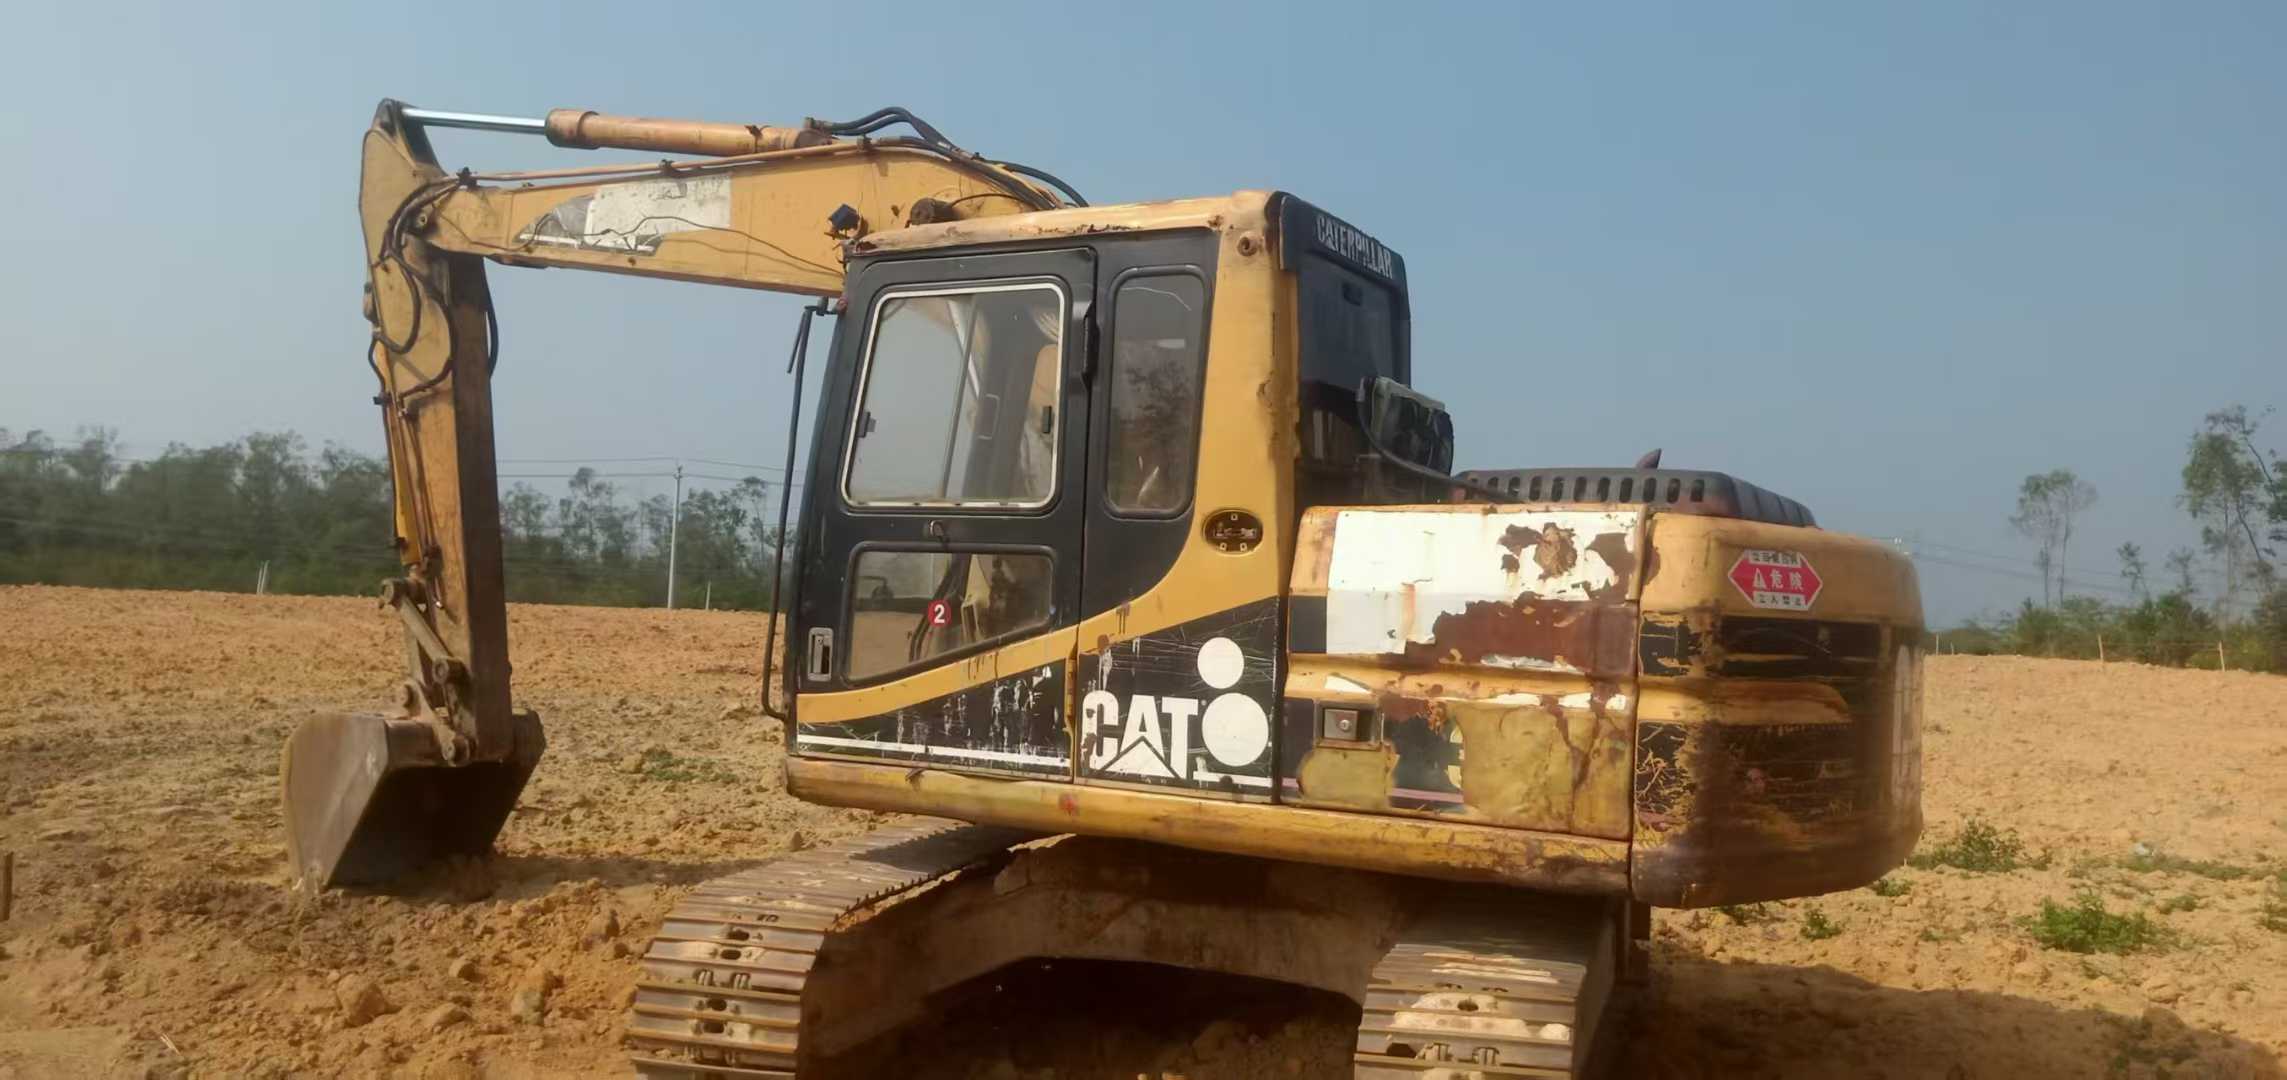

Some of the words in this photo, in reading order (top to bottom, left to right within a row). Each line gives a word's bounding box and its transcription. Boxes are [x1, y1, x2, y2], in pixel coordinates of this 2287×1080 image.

[1316, 213, 1393, 279] CATERPILLAR
[934, 603, 945, 624] 2
[1081, 689, 1199, 780] CAT
